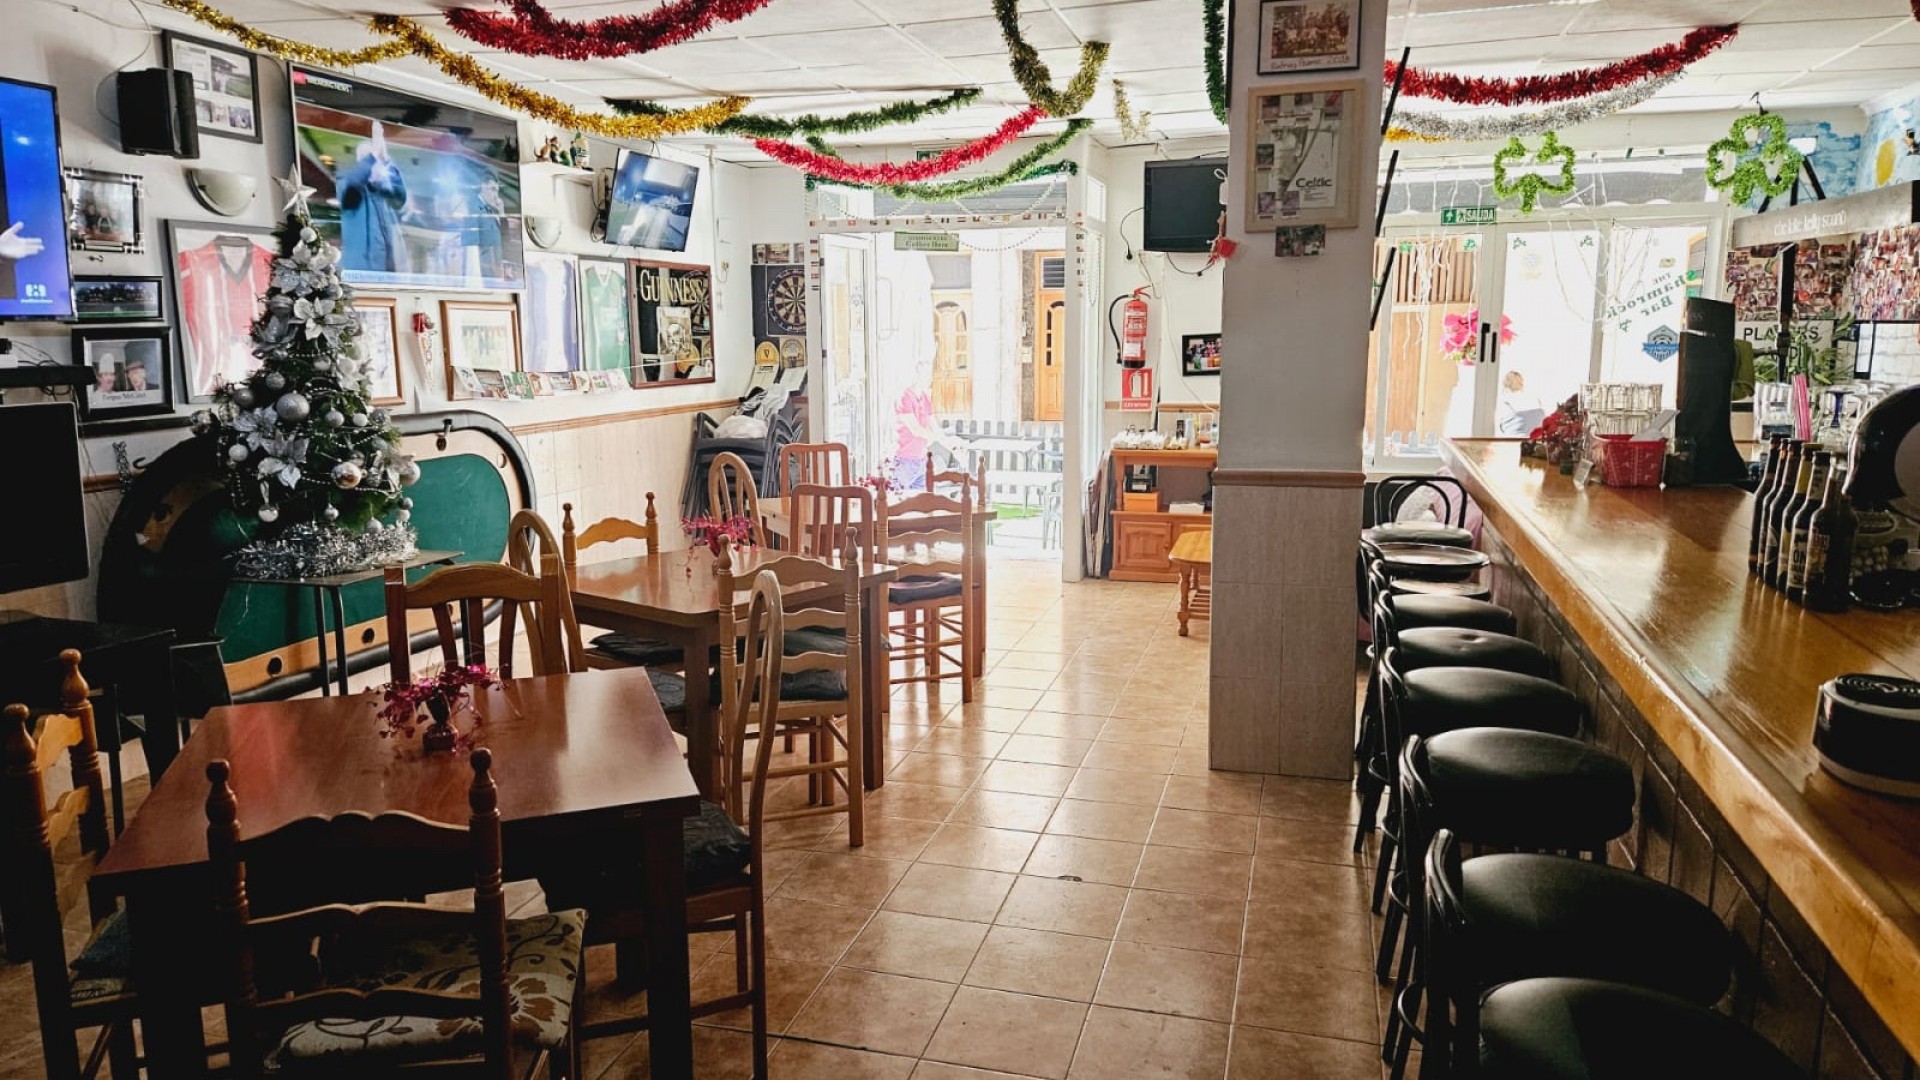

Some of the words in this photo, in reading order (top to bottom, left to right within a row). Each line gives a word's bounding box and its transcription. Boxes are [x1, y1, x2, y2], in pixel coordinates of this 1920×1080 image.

[1295, 177, 1333, 188] Celtic
[1466, 208, 1494, 222] SALIDA
[640, 269, 705, 303] GUINNESS
